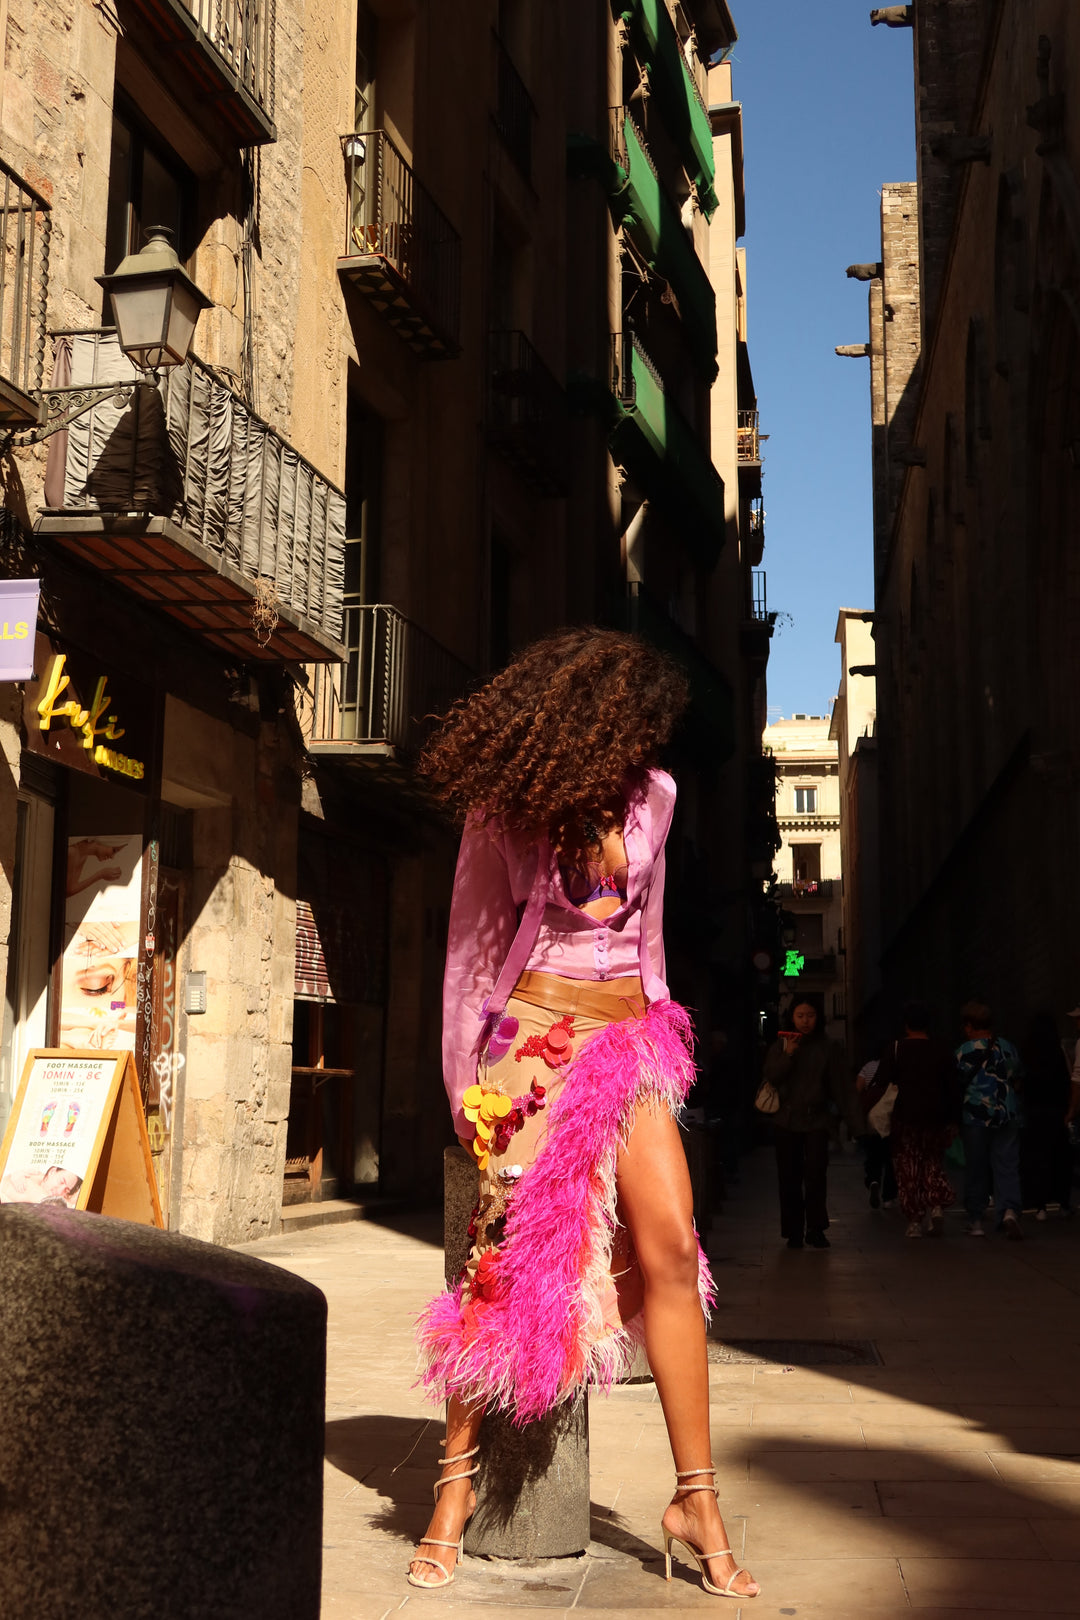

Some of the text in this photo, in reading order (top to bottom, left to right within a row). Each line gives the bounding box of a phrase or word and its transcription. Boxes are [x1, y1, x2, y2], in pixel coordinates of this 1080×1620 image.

[0, 621, 29, 640] LS
[42, 1071, 75, 1080] 10MIN
[86, 1071, 102, 1080] 8€
